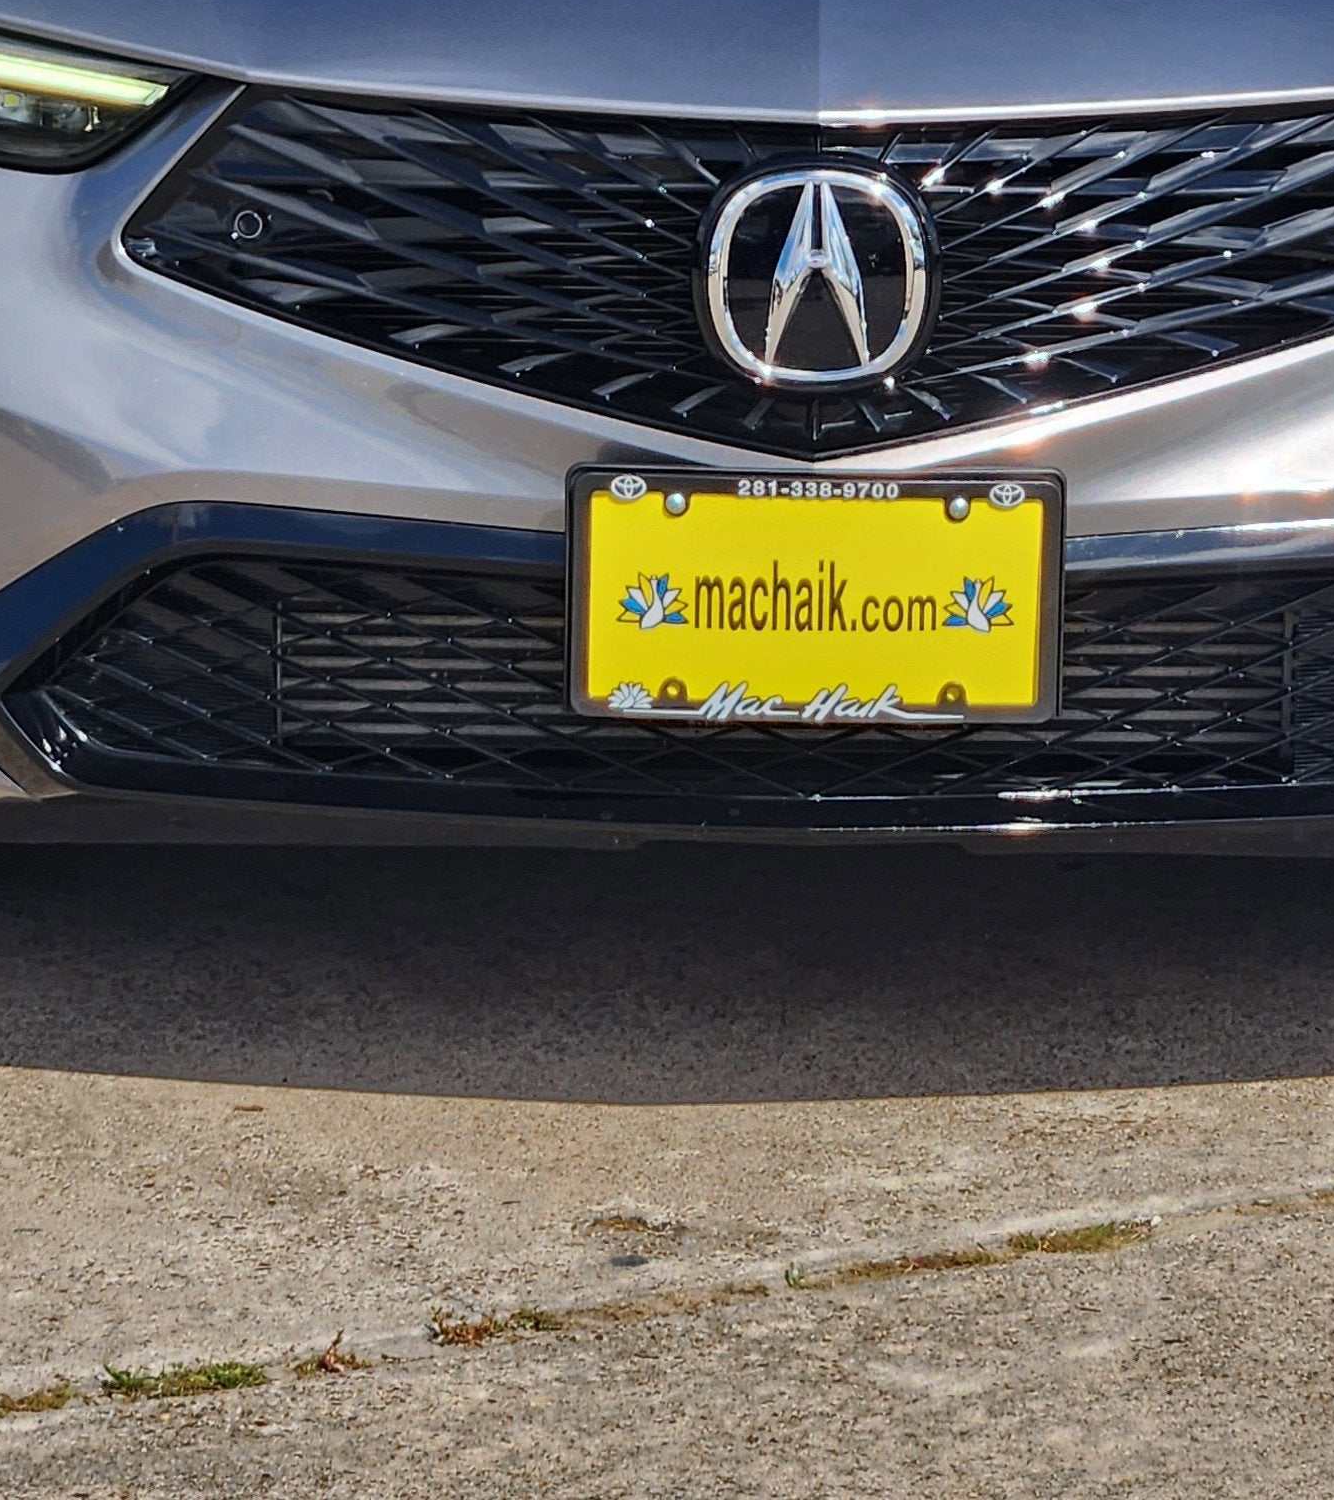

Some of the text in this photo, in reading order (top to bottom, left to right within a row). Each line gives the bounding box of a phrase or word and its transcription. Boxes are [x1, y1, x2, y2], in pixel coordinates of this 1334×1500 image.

[737, 479, 899, 499] 281-338-9700
[694, 559, 937, 632] machaik.com
[699, 681, 905, 722] Mac Haik
